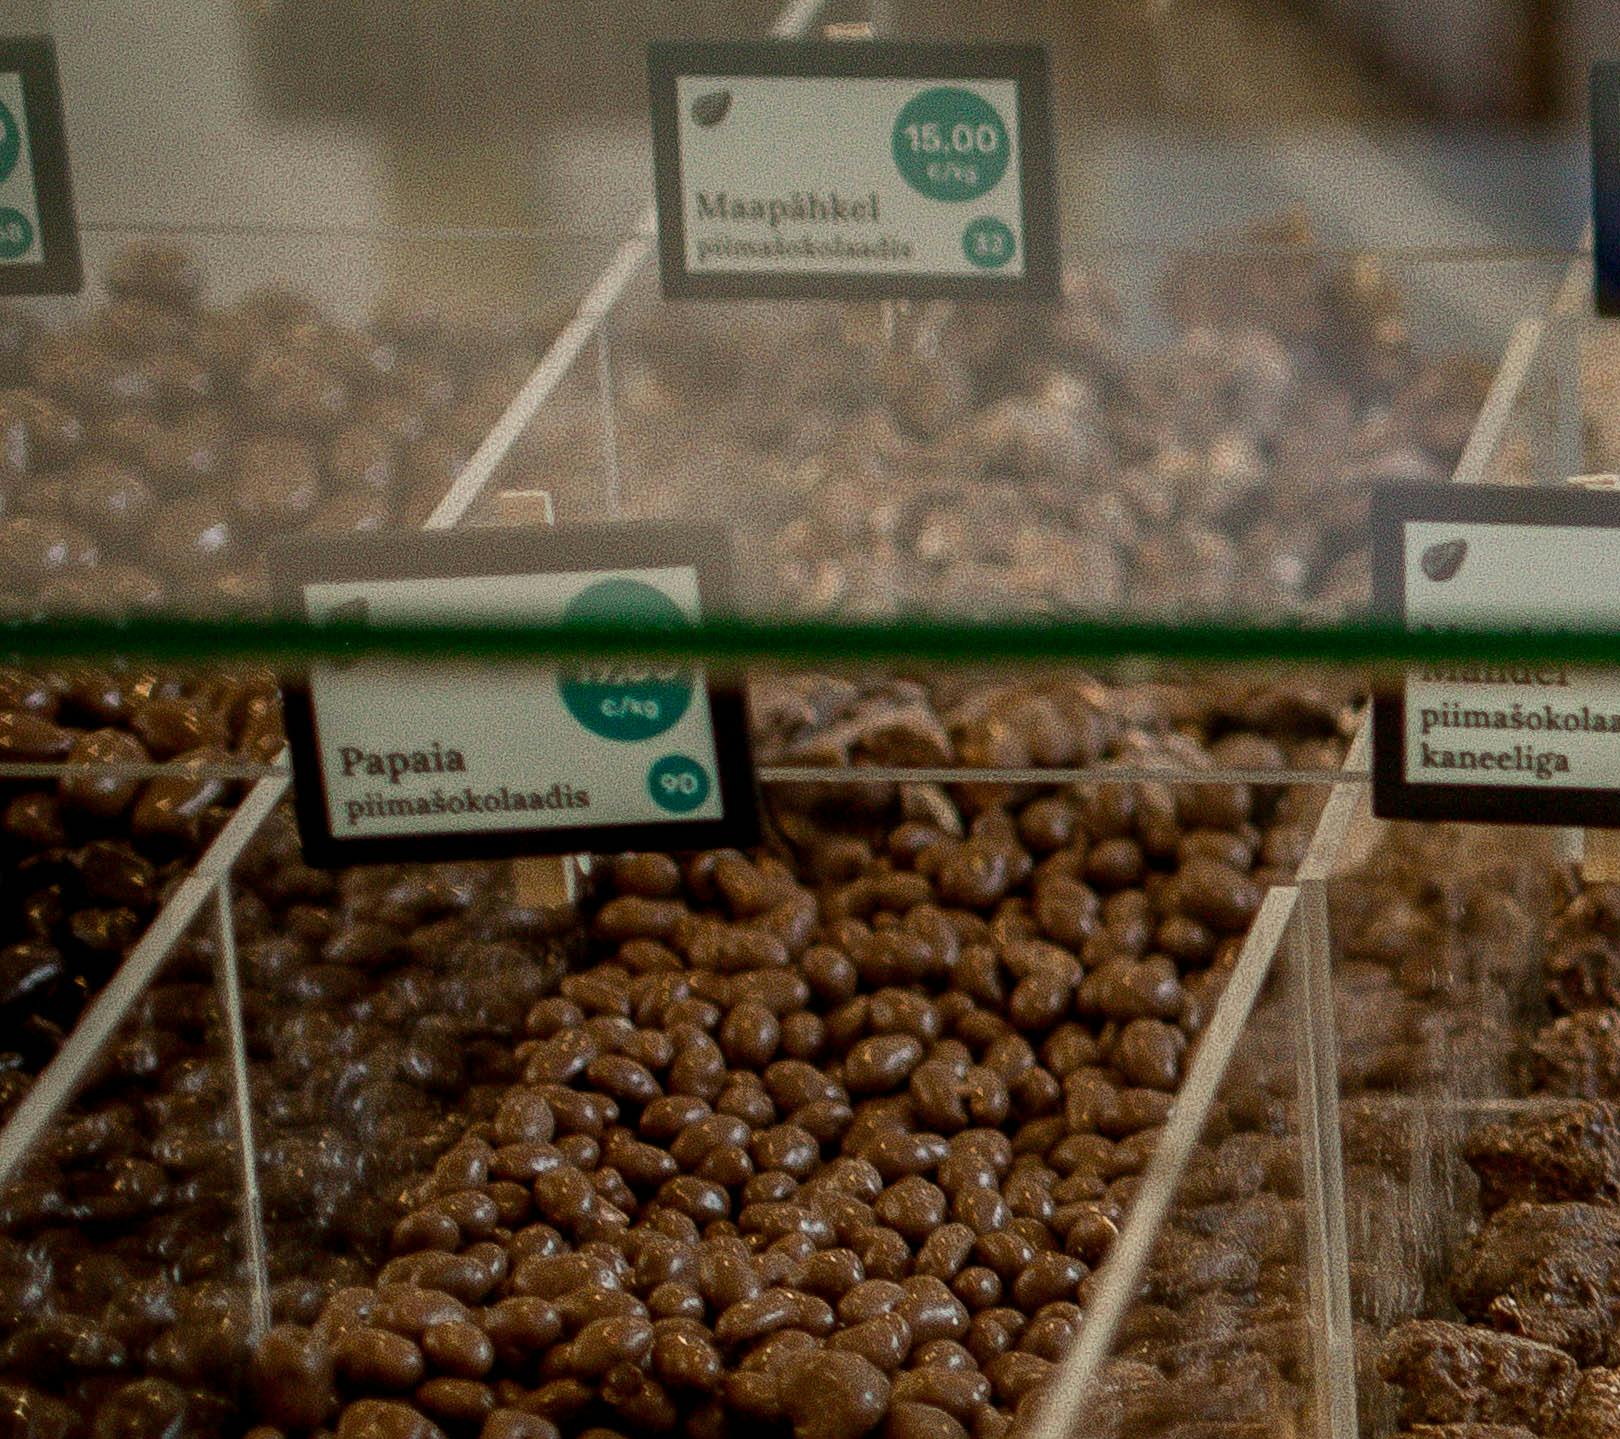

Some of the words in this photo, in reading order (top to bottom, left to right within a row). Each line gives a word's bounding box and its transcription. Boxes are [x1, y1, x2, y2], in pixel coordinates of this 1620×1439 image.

[903, 123, 999, 153] 15.00
[696, 191, 880, 227] Maapähkel
[339, 742, 467, 784] Papaia
[1420, 741, 1571, 781] kaneeliga
[344, 783, 591, 826] piimašokolaadis
